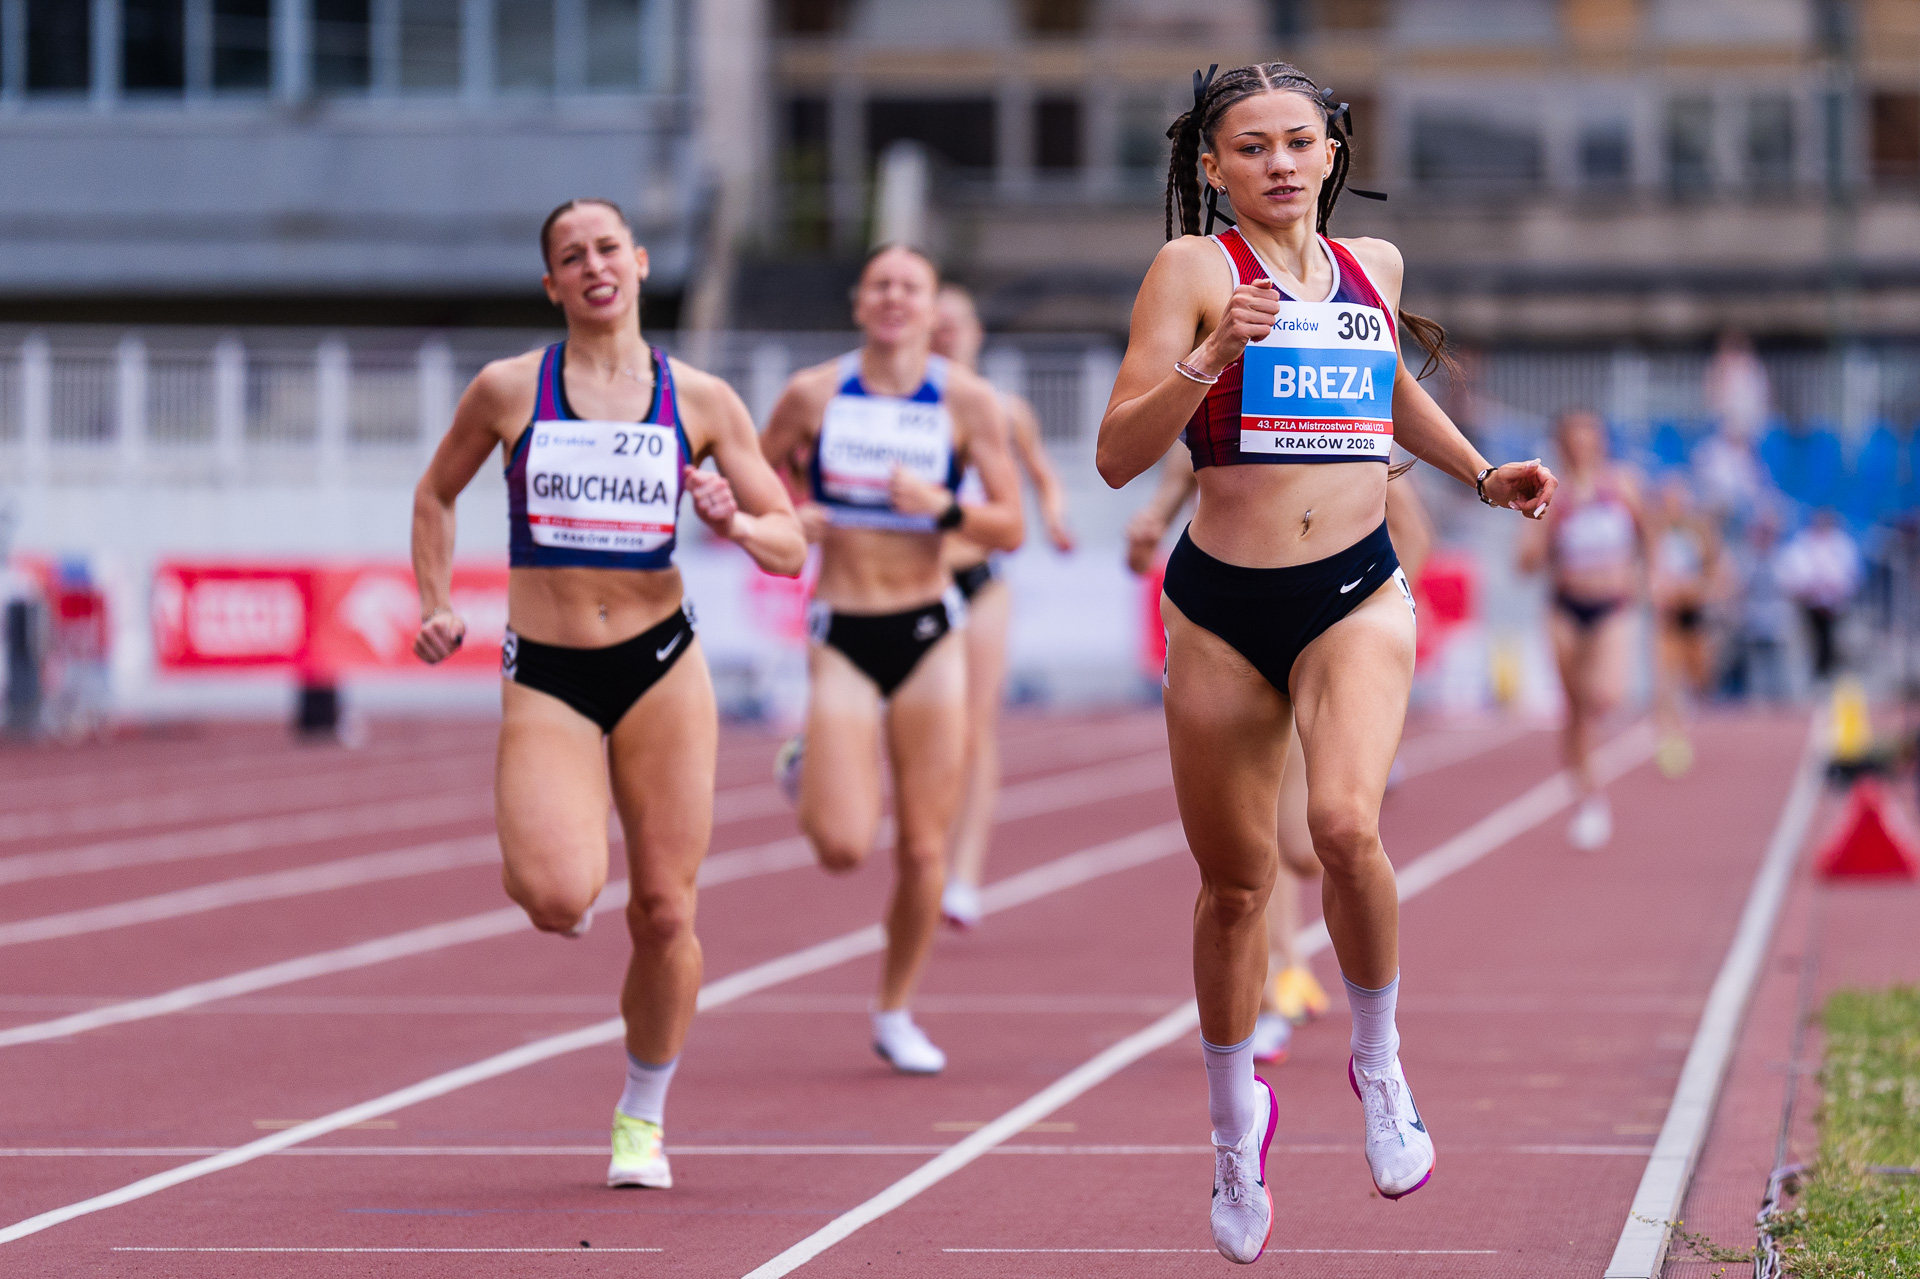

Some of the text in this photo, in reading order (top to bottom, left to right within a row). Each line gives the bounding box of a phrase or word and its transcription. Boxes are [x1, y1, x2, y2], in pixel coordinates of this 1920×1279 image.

[1273, 317, 1319, 332] Kraków
[1337, 311, 1381, 341] 309
[1273, 364, 1375, 400] BREZA
[1257, 420, 1385, 432] 43. PZLA Mistrzostwa Polski U23
[613, 432, 663, 457] 270
[1275, 435, 1375, 450] KRAKÓW 2026
[533, 472, 668, 505] GRUCHAŁA
